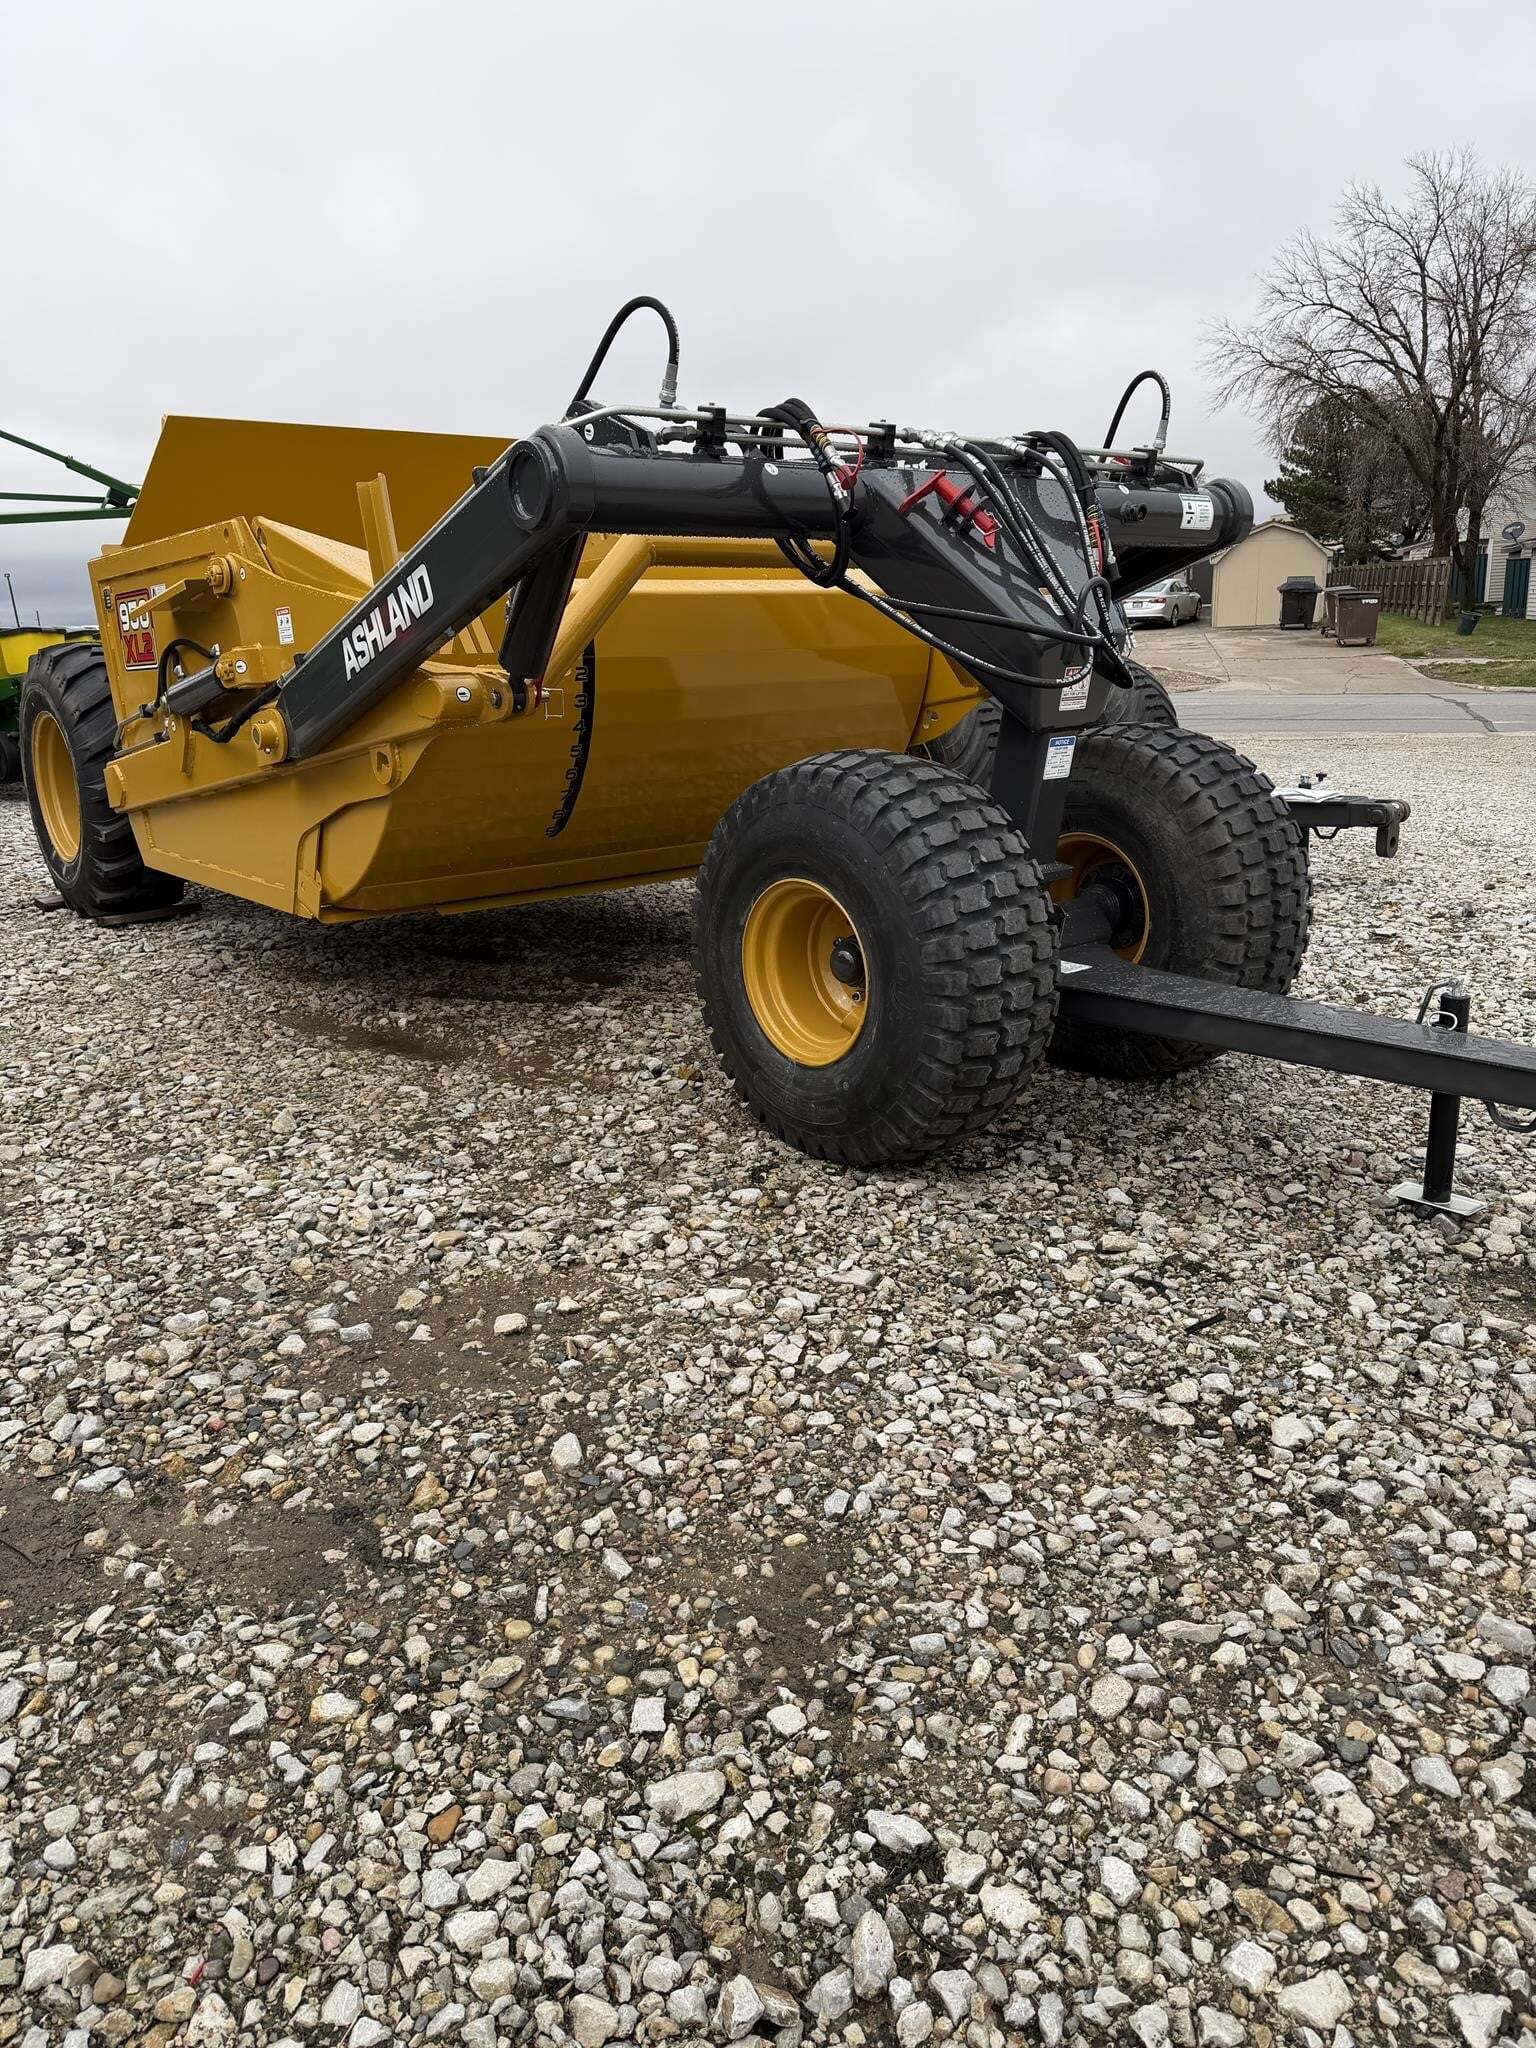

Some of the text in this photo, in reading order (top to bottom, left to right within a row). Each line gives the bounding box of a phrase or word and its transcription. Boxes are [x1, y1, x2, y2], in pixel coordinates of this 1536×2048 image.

[119, 599, 150, 632] 950
[342, 564, 434, 681] ASHLAND
[123, 632, 155, 664] XL2
[575, 666, 588, 682] 2
[574, 694, 588, 708] 3
[572, 719, 586, 733] 4
[570, 745, 583, 758] 5
[565, 768, 578, 780] 6
